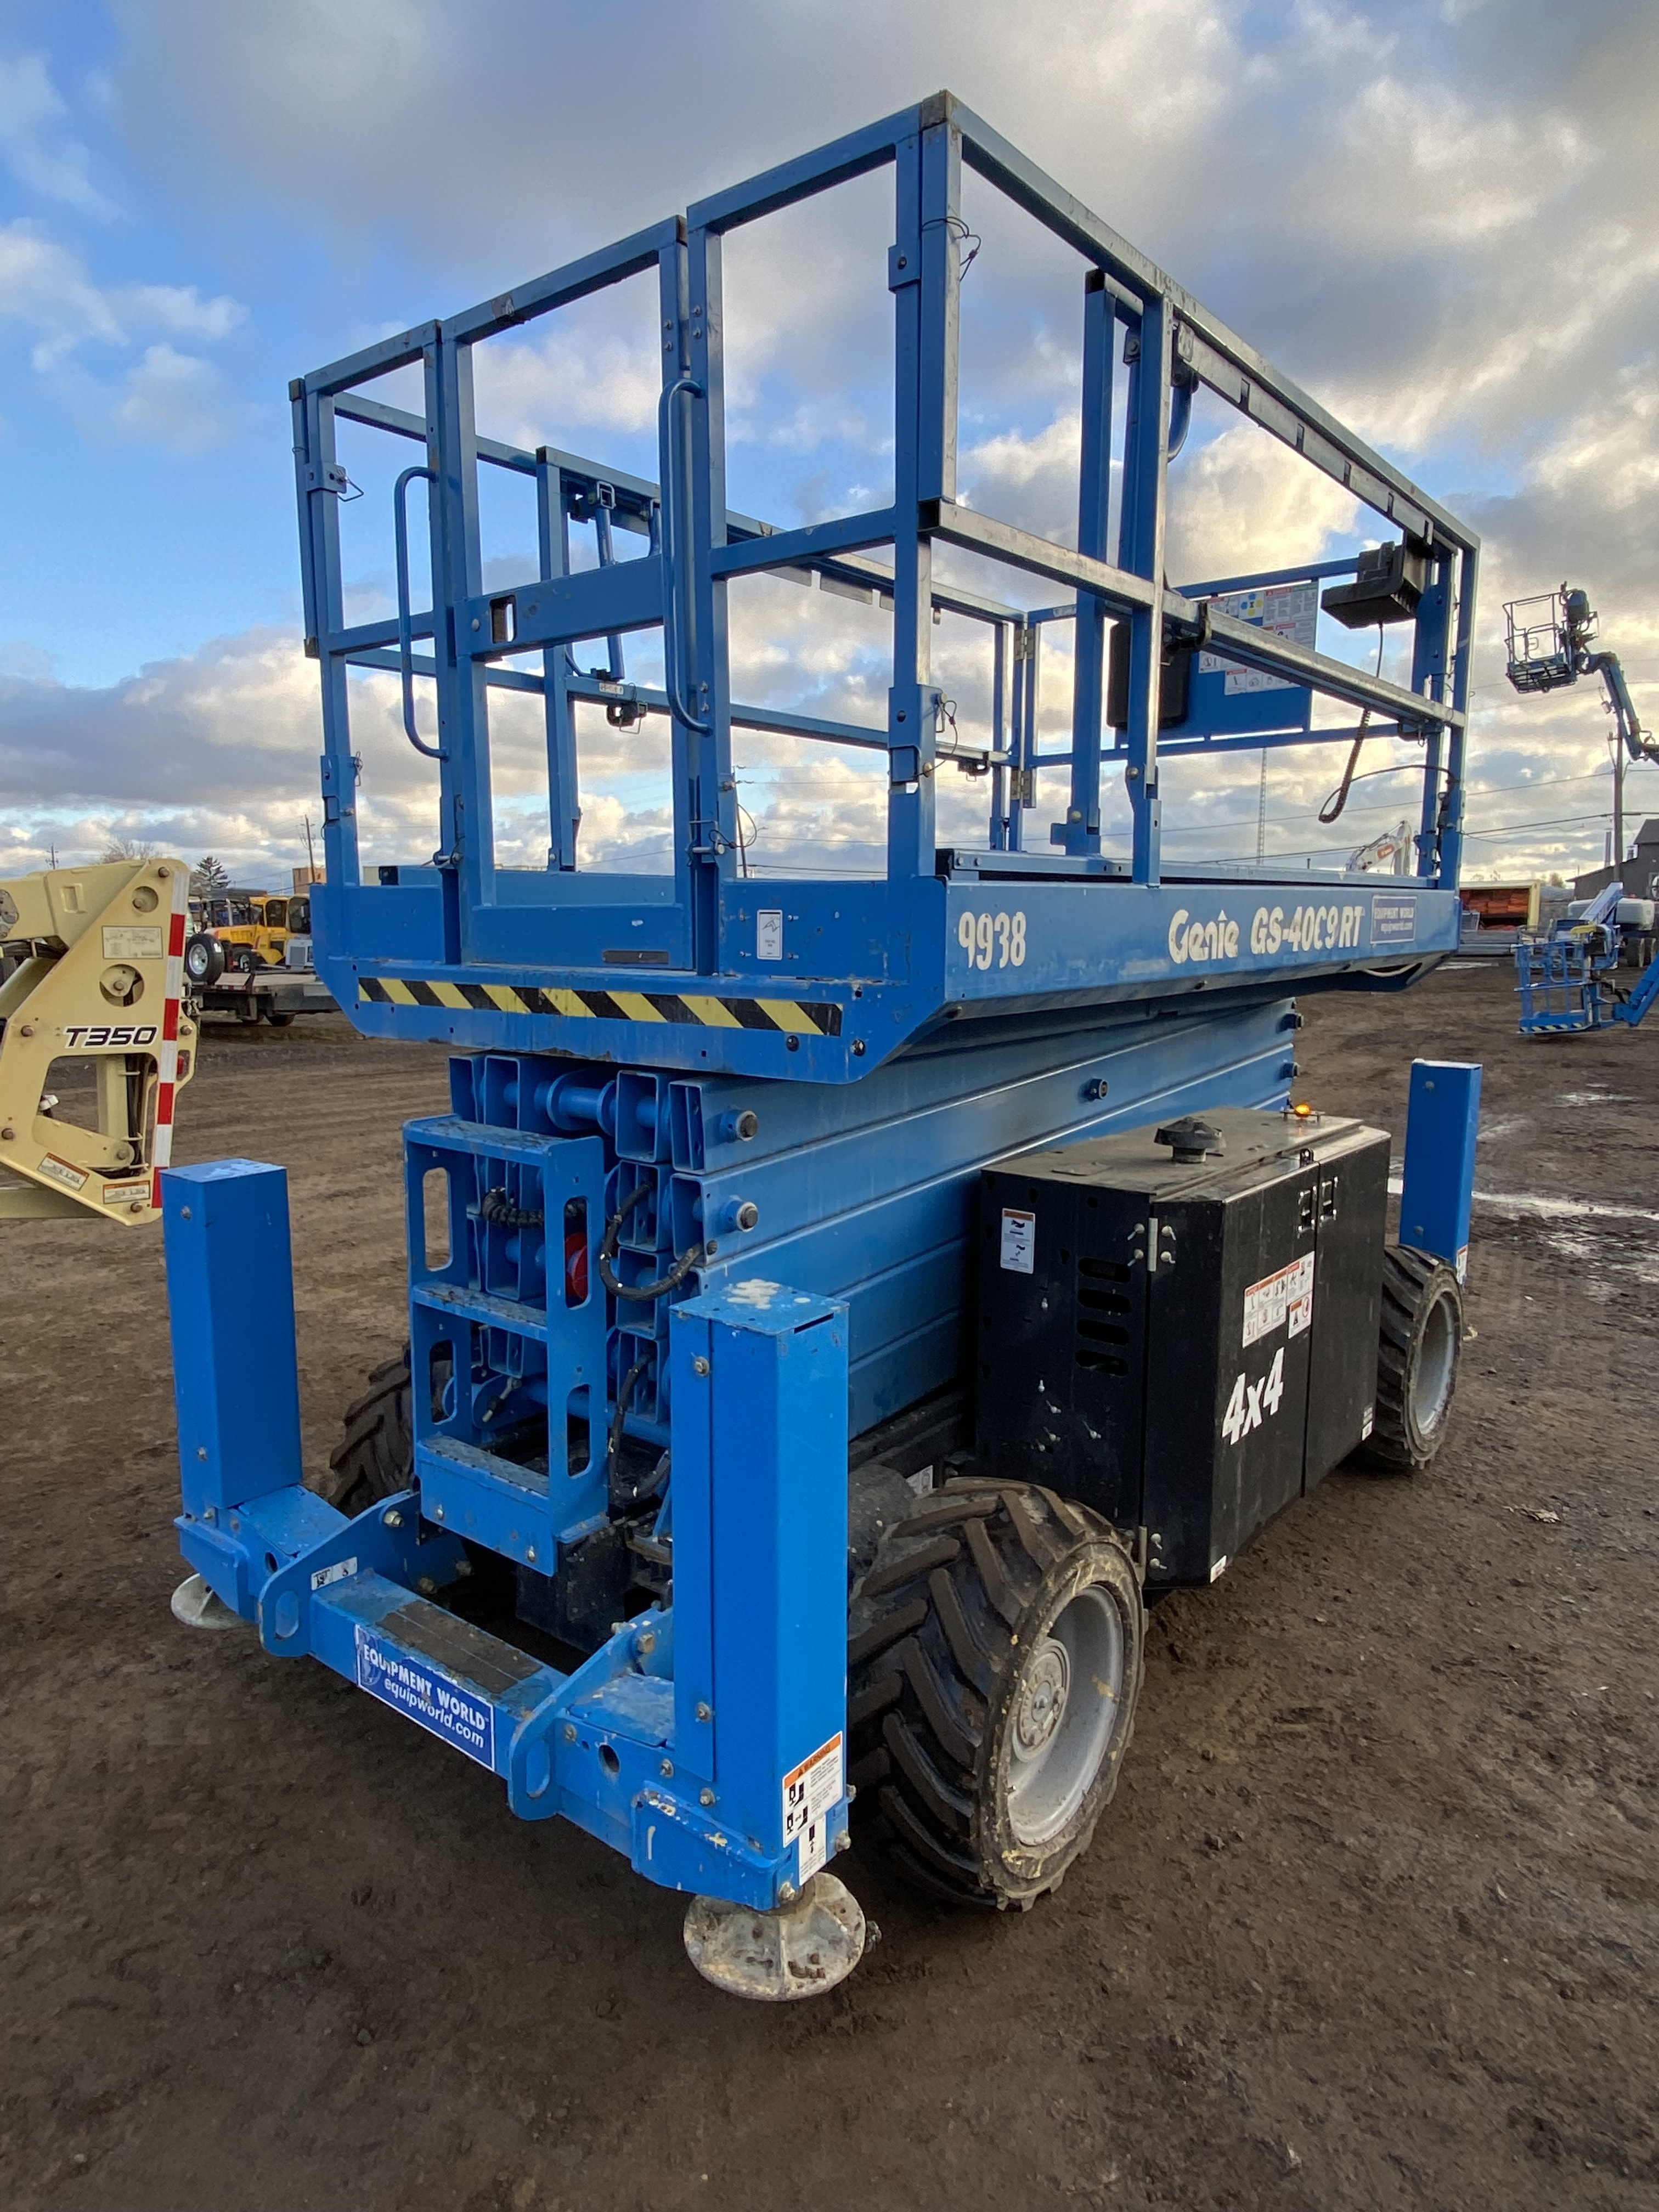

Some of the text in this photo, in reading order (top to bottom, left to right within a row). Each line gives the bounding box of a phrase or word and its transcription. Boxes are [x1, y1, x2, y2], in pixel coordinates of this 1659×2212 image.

[958, 911, 1026, 970] 9938
[1168, 909, 1240, 964] Genie
[65, 1026, 158, 1047] T350
[1222, 1347, 1284, 1445] 4x4
[364, 1644, 485, 1731] EQUIPMENT WORLD
[385, 1678, 484, 1748] equipworld.com
